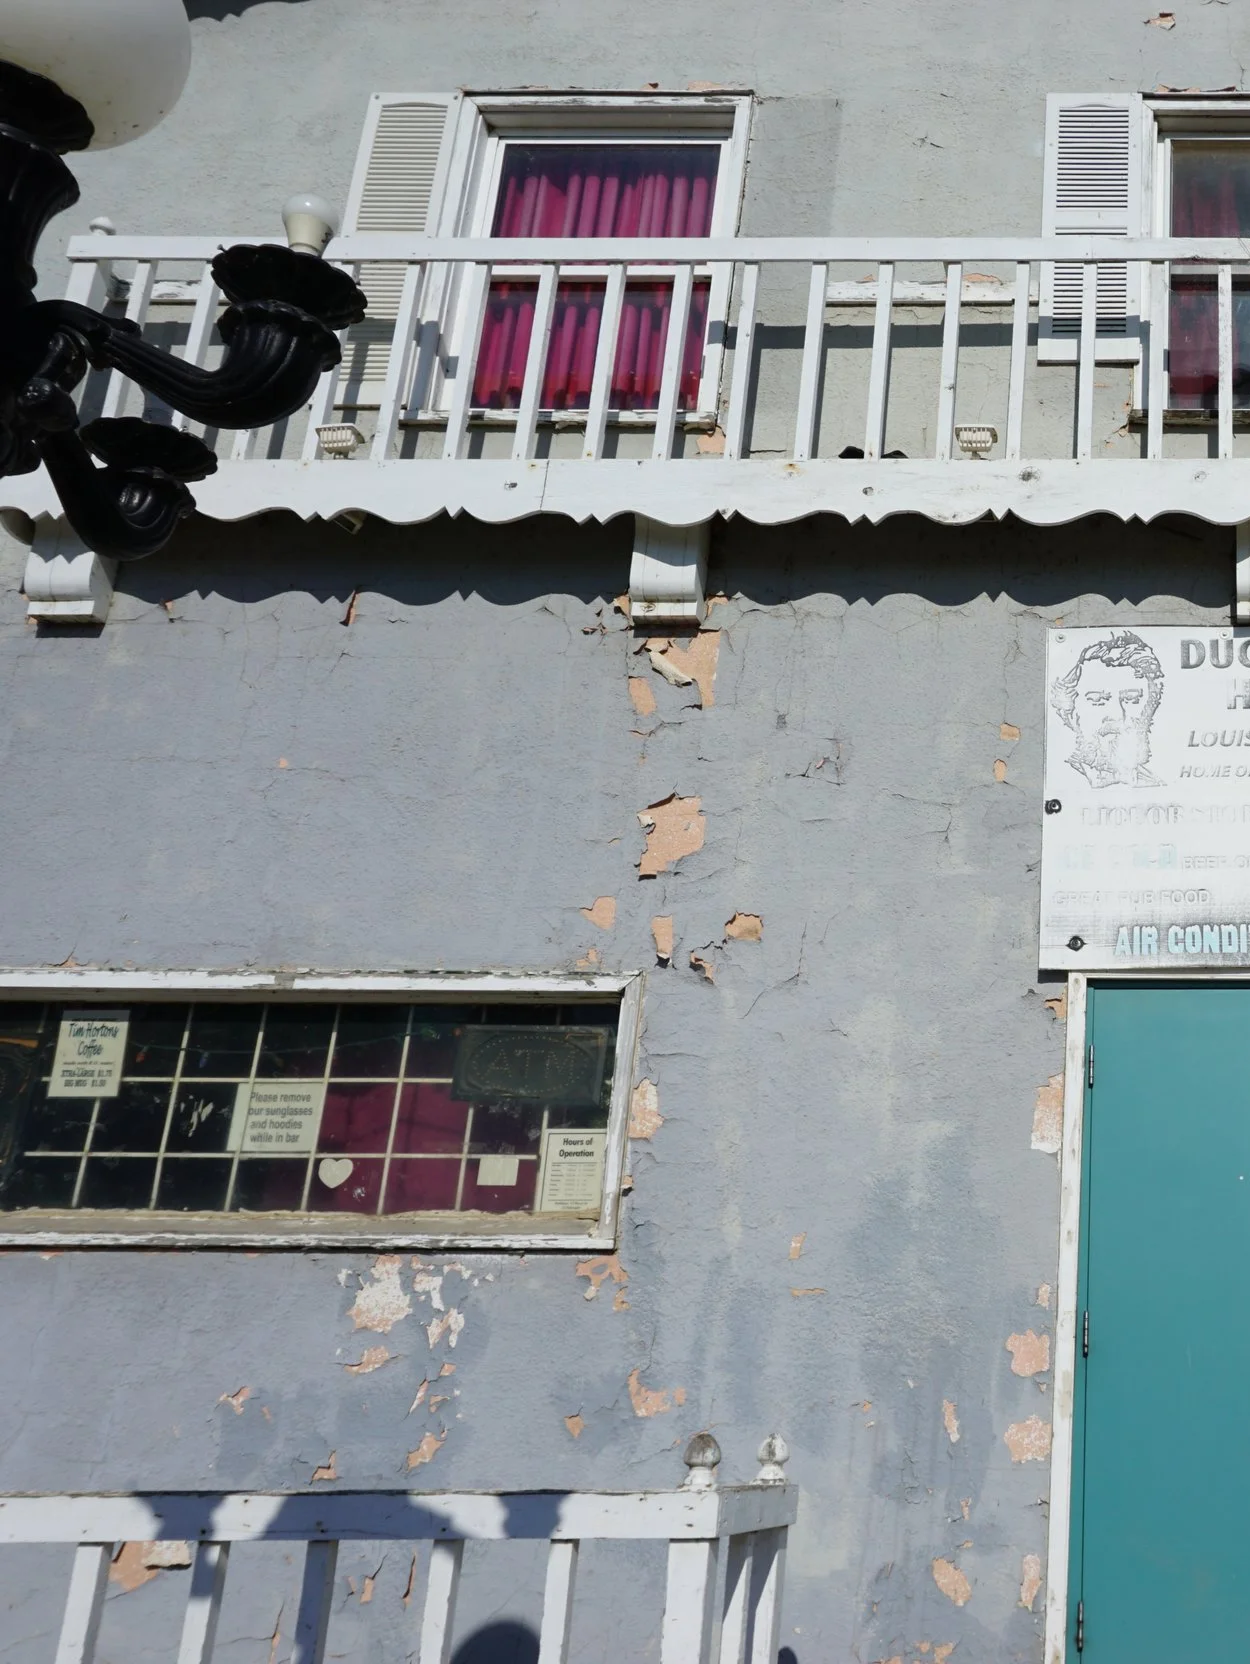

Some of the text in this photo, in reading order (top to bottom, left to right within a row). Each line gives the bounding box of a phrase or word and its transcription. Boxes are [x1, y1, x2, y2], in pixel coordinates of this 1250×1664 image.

[1179, 764, 1231, 778] HOME
[1159, 888, 1212, 904] FOOD
[1114, 924, 1159, 957] AIR
[68, 1022, 120, 1038] Tim Hortons
[77, 1039, 104, 1059] Coffee
[250, 1091, 312, 1103] Please remove
[247, 1106, 313, 1118] our sunglasses
[250, 1119, 303, 1129] and hoodies
[250, 1131, 300, 1143] while in bar
[563, 1137, 594, 1146] Hours of
[559, 1149, 595, 1158] Operation
